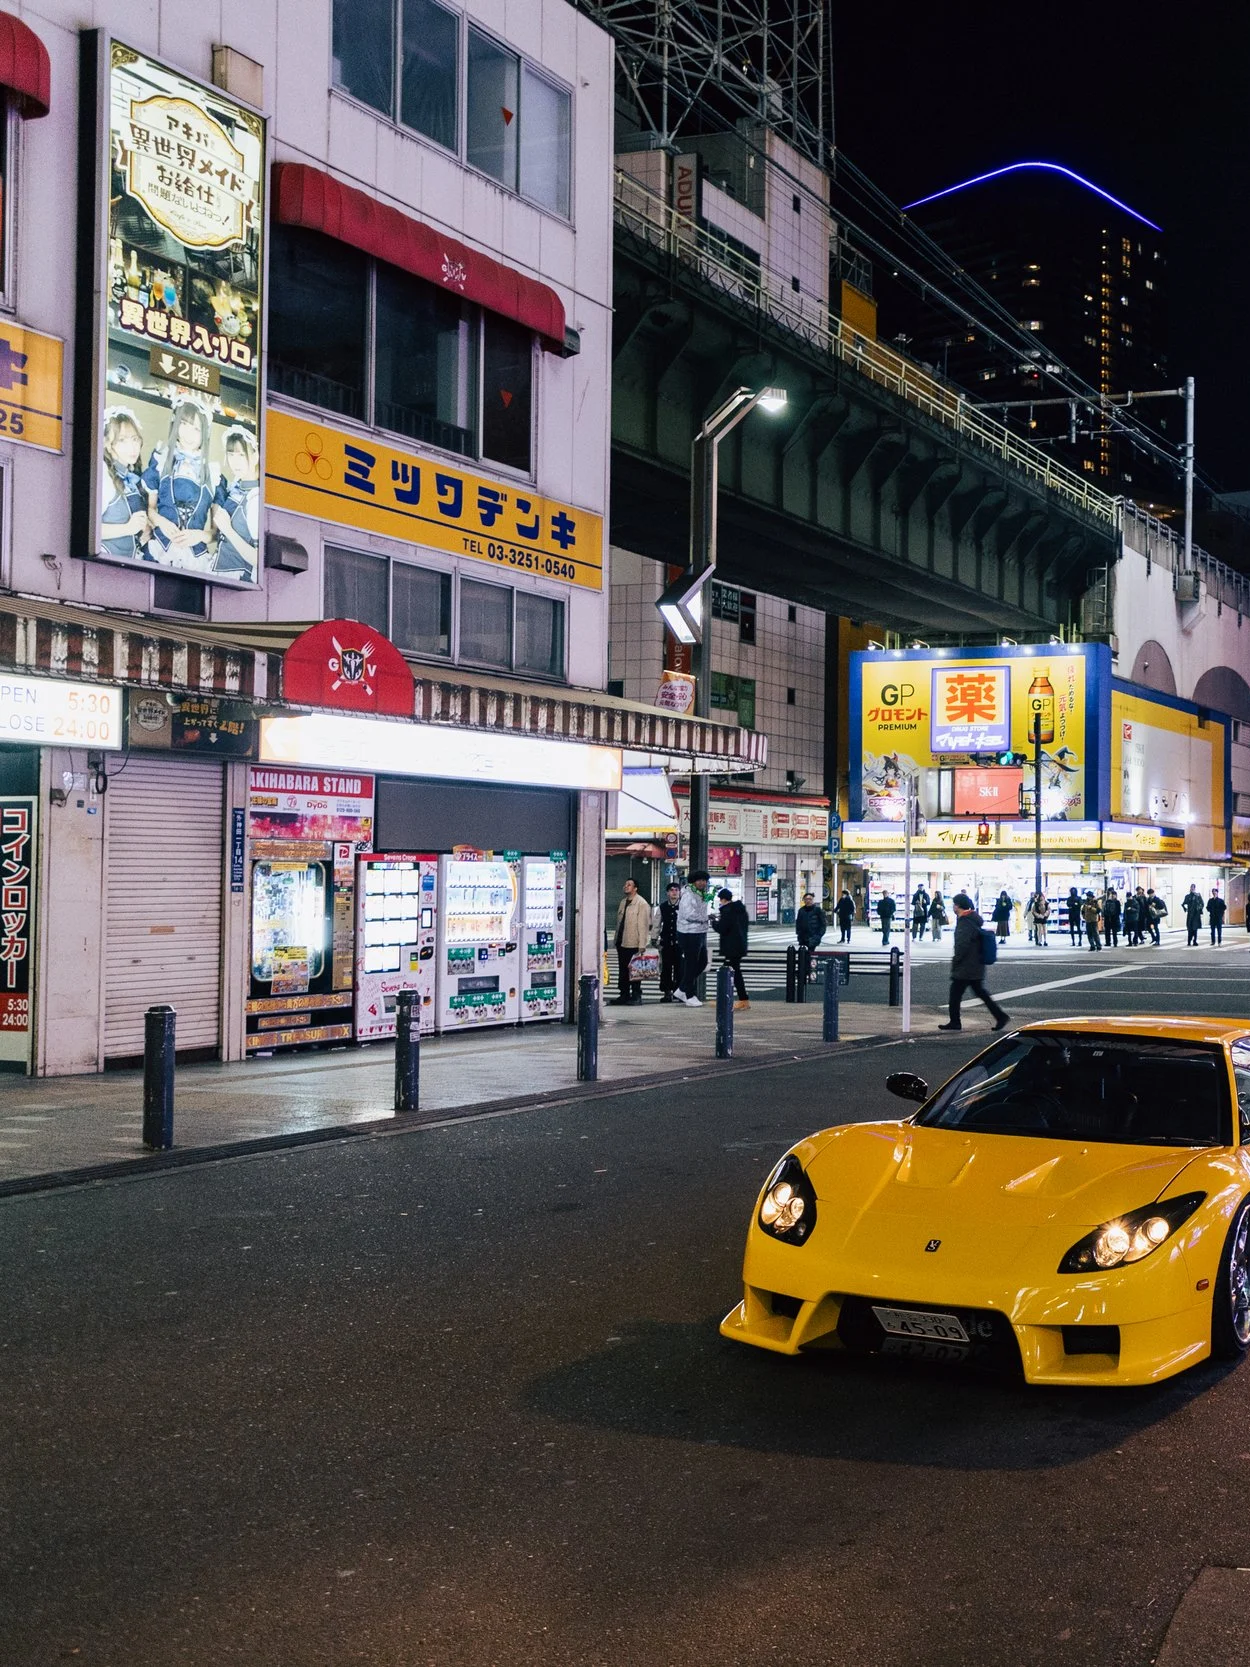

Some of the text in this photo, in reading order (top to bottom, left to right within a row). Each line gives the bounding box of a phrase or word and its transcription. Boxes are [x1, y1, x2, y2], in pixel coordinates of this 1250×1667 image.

[166, 114, 210, 147] アキバ
[130, 122, 246, 192] 異世界メイド
[156, 164, 214, 206] お給仕
[121, 300, 251, 368] 異世界入り口
[177, 360, 210, 387] 2階
[344, 444, 576, 550] ミツワデンキ
[462, 537, 576, 580] TEL 03-3251-0540
[328, 657, 340, 672] G
[366, 663, 377, 677] V
[68, 691, 111, 715] 5:30
[880, 684, 915, 706] GP
[946, 673, 996, 723] 薬
[1031, 698, 1051, 711] GP
[867, 707, 928, 722] グロモント
[53, 716, 110, 740] 24:00
[878, 723, 917, 731] PREMIUM
[250, 771, 362, 794] AKIHABARA STAND
[306, 801, 328, 810] DyDo
[384, 853, 417, 862] Sevens Crepe
[1, 808, 30, 988] コインロッカー
[7, 998, 29, 1012] 5:30
[2, 1013, 29, 1027] 24:00
[900, 1320, 963, 1340] 45-09
